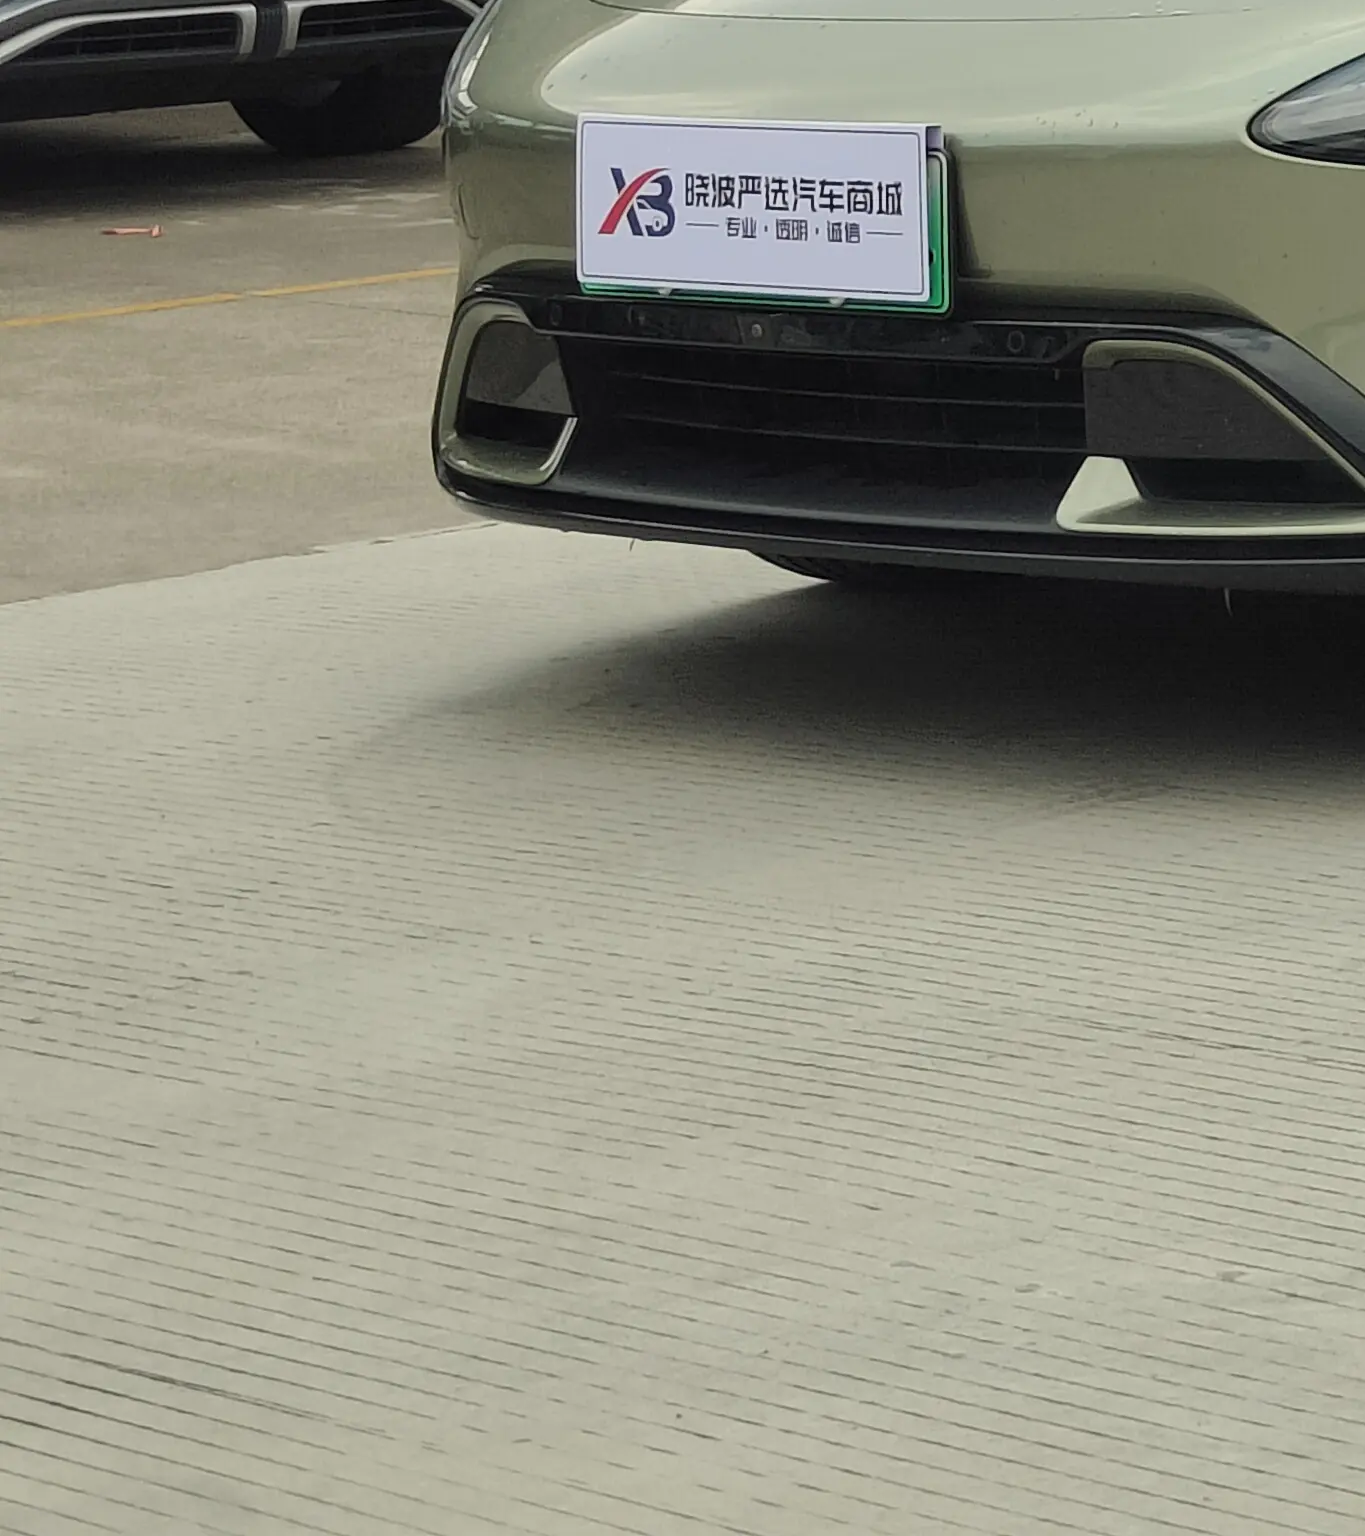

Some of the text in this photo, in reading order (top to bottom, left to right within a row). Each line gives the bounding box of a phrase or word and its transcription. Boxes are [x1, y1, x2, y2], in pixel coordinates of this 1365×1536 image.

[685, 172, 904, 216] 晓波严选汽车商城
